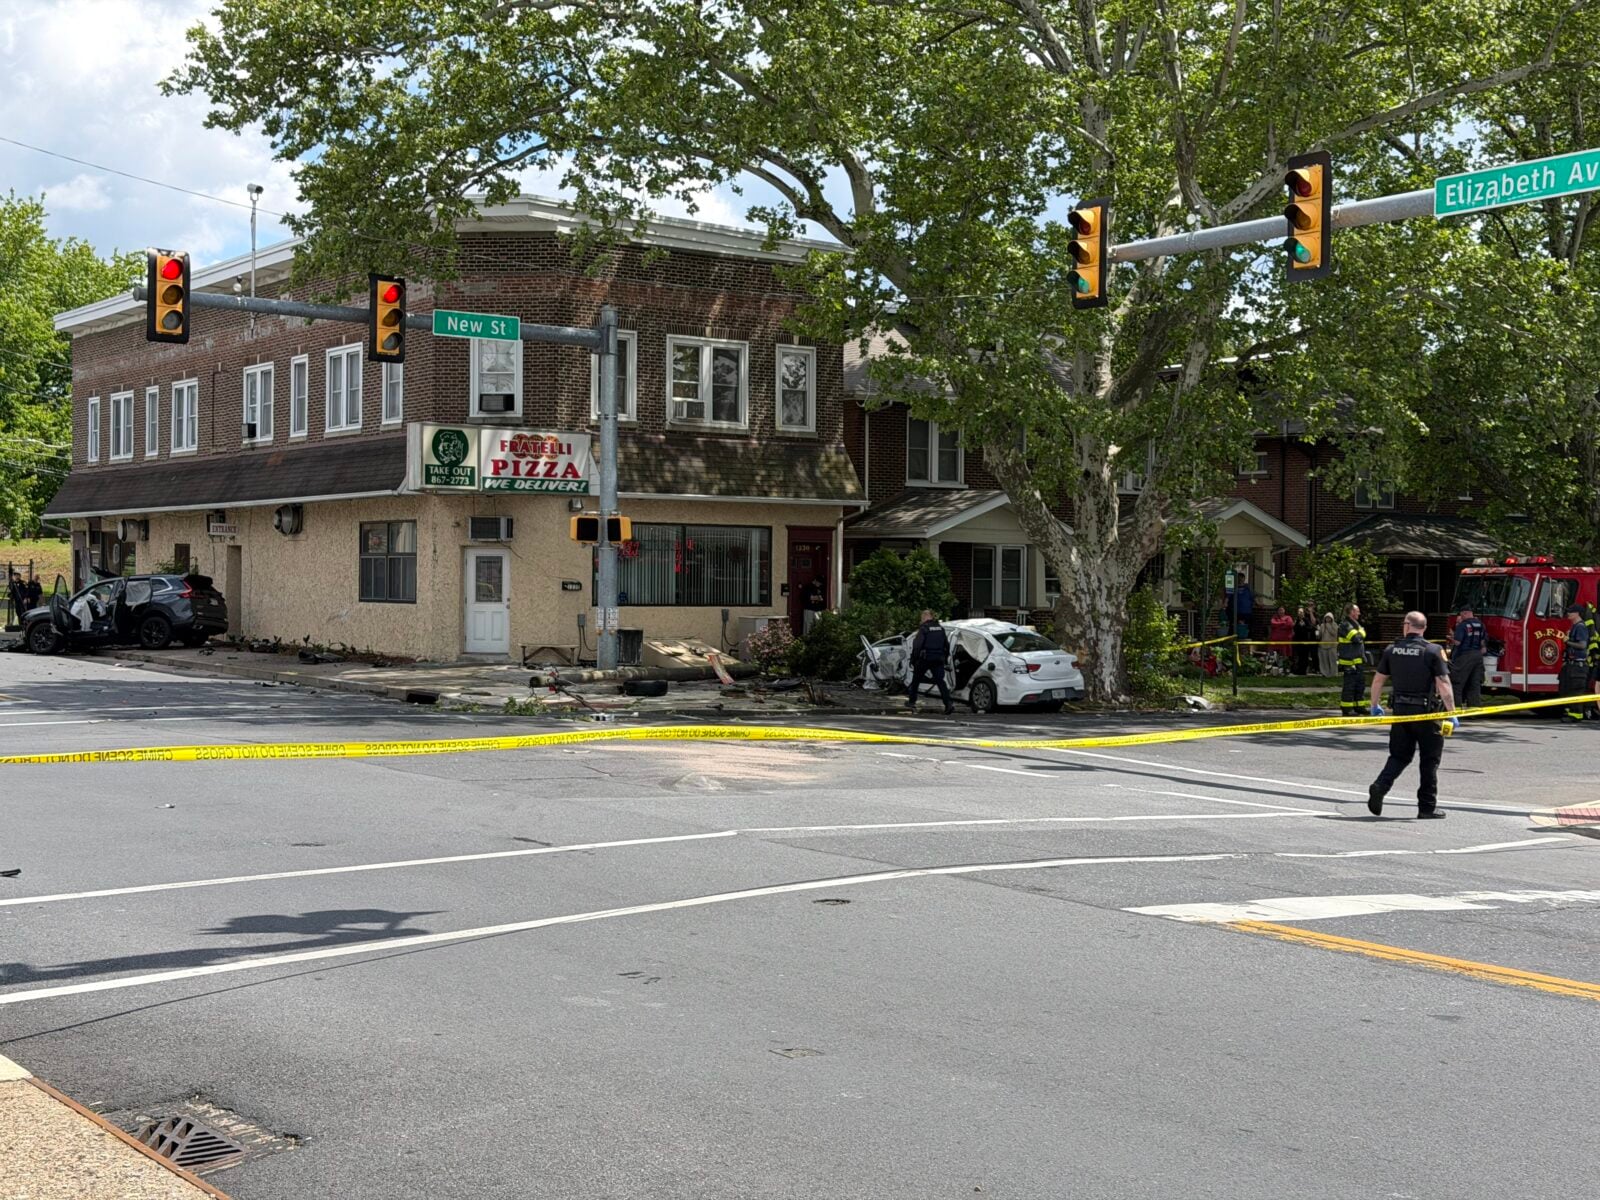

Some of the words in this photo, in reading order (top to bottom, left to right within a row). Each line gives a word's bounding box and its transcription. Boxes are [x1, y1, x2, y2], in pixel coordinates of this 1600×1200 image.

[1445, 165, 1556, 206] Elizabeth
[447, 316, 483, 333] New
[490, 320, 506, 336] St
[499, 439, 572, 456] FRATELLI
[429, 465, 450, 475] TAKE
[452, 466, 472, 476] OUT
[490, 459, 582, 479] PIZZA
[431, 475, 470, 485] 867-2773
[484, 478, 509, 489] WE
[514, 479, 587, 492] DELIVER!
[1392, 647, 1420, 656] POLICE
